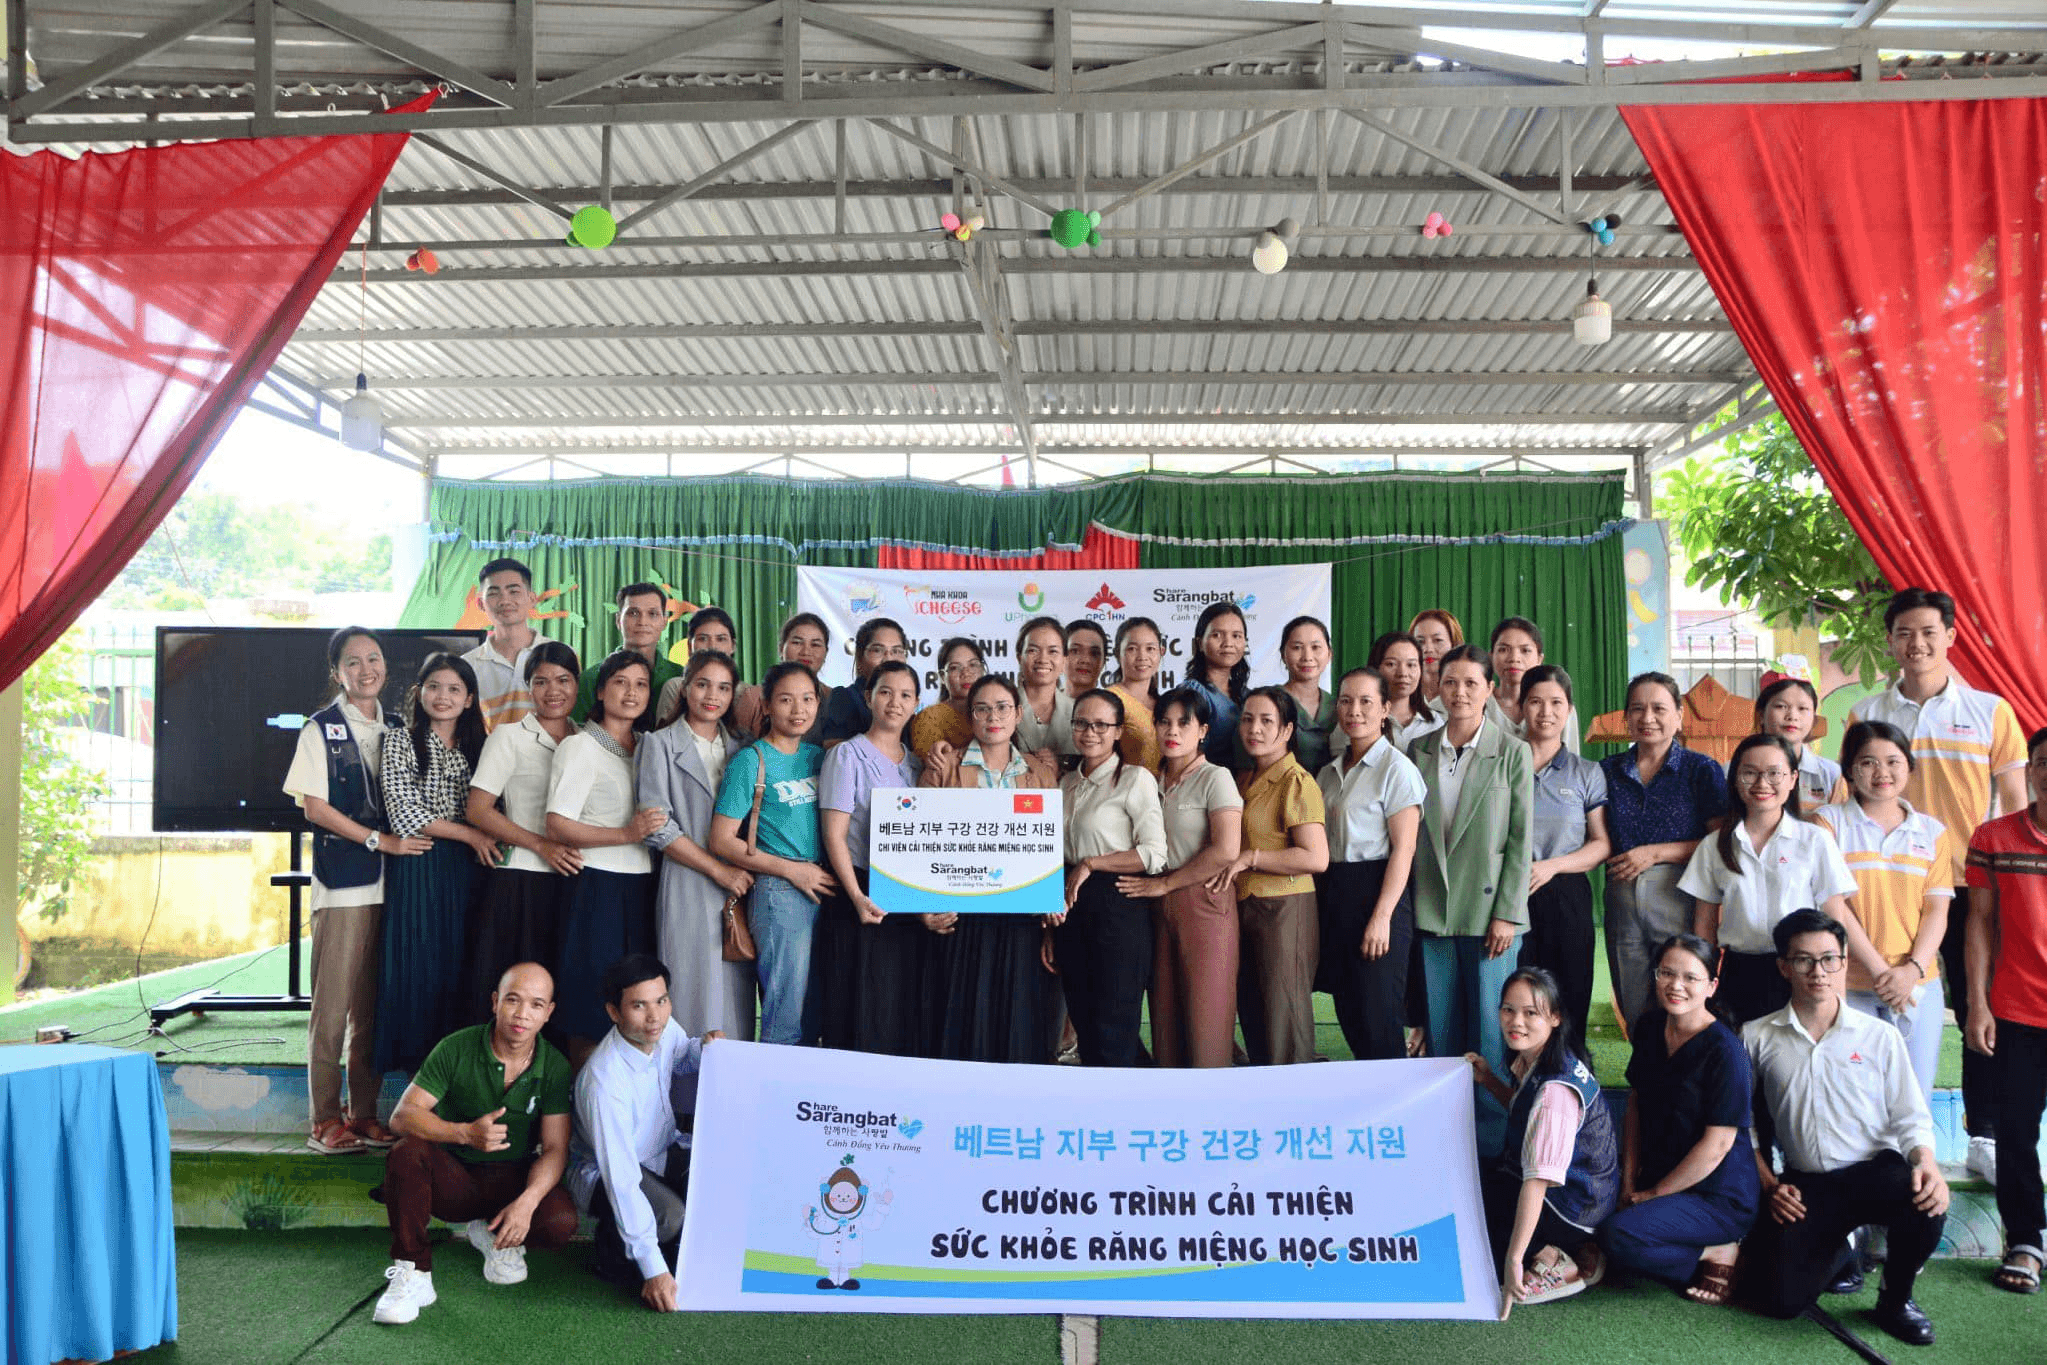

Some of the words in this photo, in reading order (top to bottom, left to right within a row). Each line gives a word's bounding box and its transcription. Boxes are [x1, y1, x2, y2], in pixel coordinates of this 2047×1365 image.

[1153, 588, 1234, 605] Sarangbat
[879, 822, 915, 836] 베트남
[919, 822, 943, 836] 지부
[947, 822, 971, 837] 구강
[976, 822, 999, 837] 건강
[1004, 822, 1027, 837] 개선
[1032, 822, 1055, 837] 지원
[878, 842, 889, 852] CHI
[1037, 843, 1054, 853] SINH
[930, 862, 987, 876] Sarangbat
[796, 1101, 897, 1128] Sarangbat
[954, 1125, 1044, 1160] 베트남
[1057, 1128, 1117, 1161] 지부
[1128, 1129, 1189, 1162] 구강
[1202, 1129, 1261, 1160] 건강
[1274, 1126, 1334, 1160] 개선
[1347, 1126, 1407, 1160] 지원
[982, 1186, 1098, 1215] CHƯƠNG
[1109, 1184, 1196, 1216] TRÌNH
[1208, 1182, 1255, 1216] CẢI
[1266, 1184, 1354, 1221] THIỆN
[930, 1227, 989, 1259] SỨC
[1000, 1226, 1078, 1260] KHỎE
[1088, 1230, 1167, 1261] RĂNG
[1178, 1230, 1267, 1268] MIỆNG
[1279, 1236, 1338, 1268] HỌC
[1348, 1236, 1418, 1262] SINH
